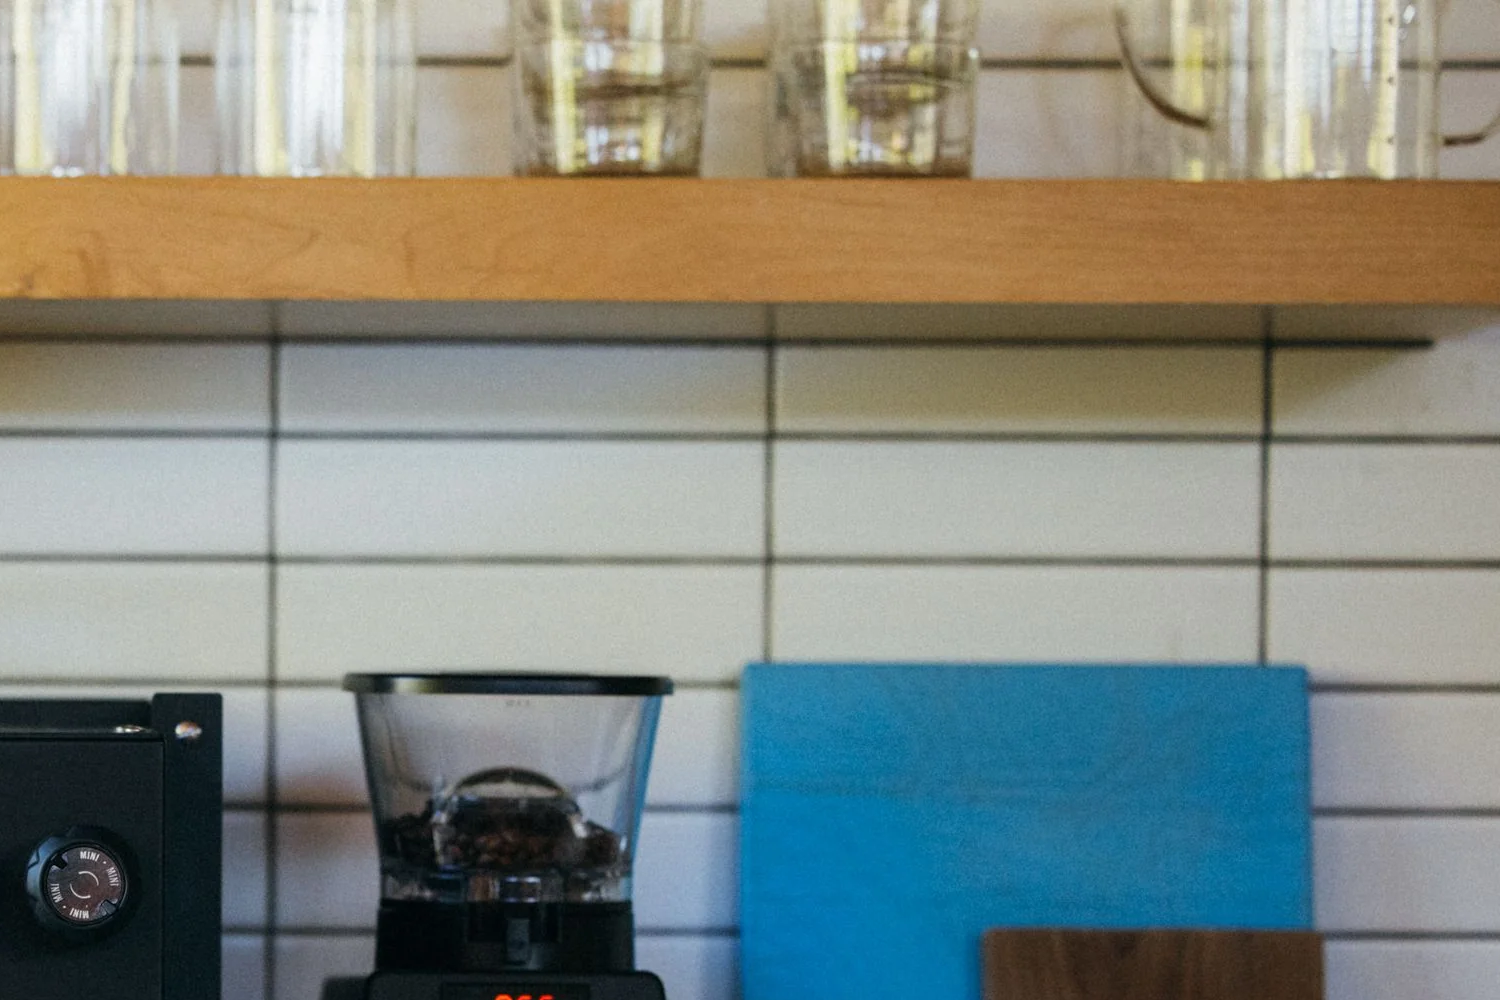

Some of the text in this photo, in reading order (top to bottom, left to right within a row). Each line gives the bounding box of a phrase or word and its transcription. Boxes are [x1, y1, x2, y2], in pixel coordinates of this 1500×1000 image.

[79, 850, 120, 887] MINI MINI
[50, 883, 90, 919] MINI MINI
